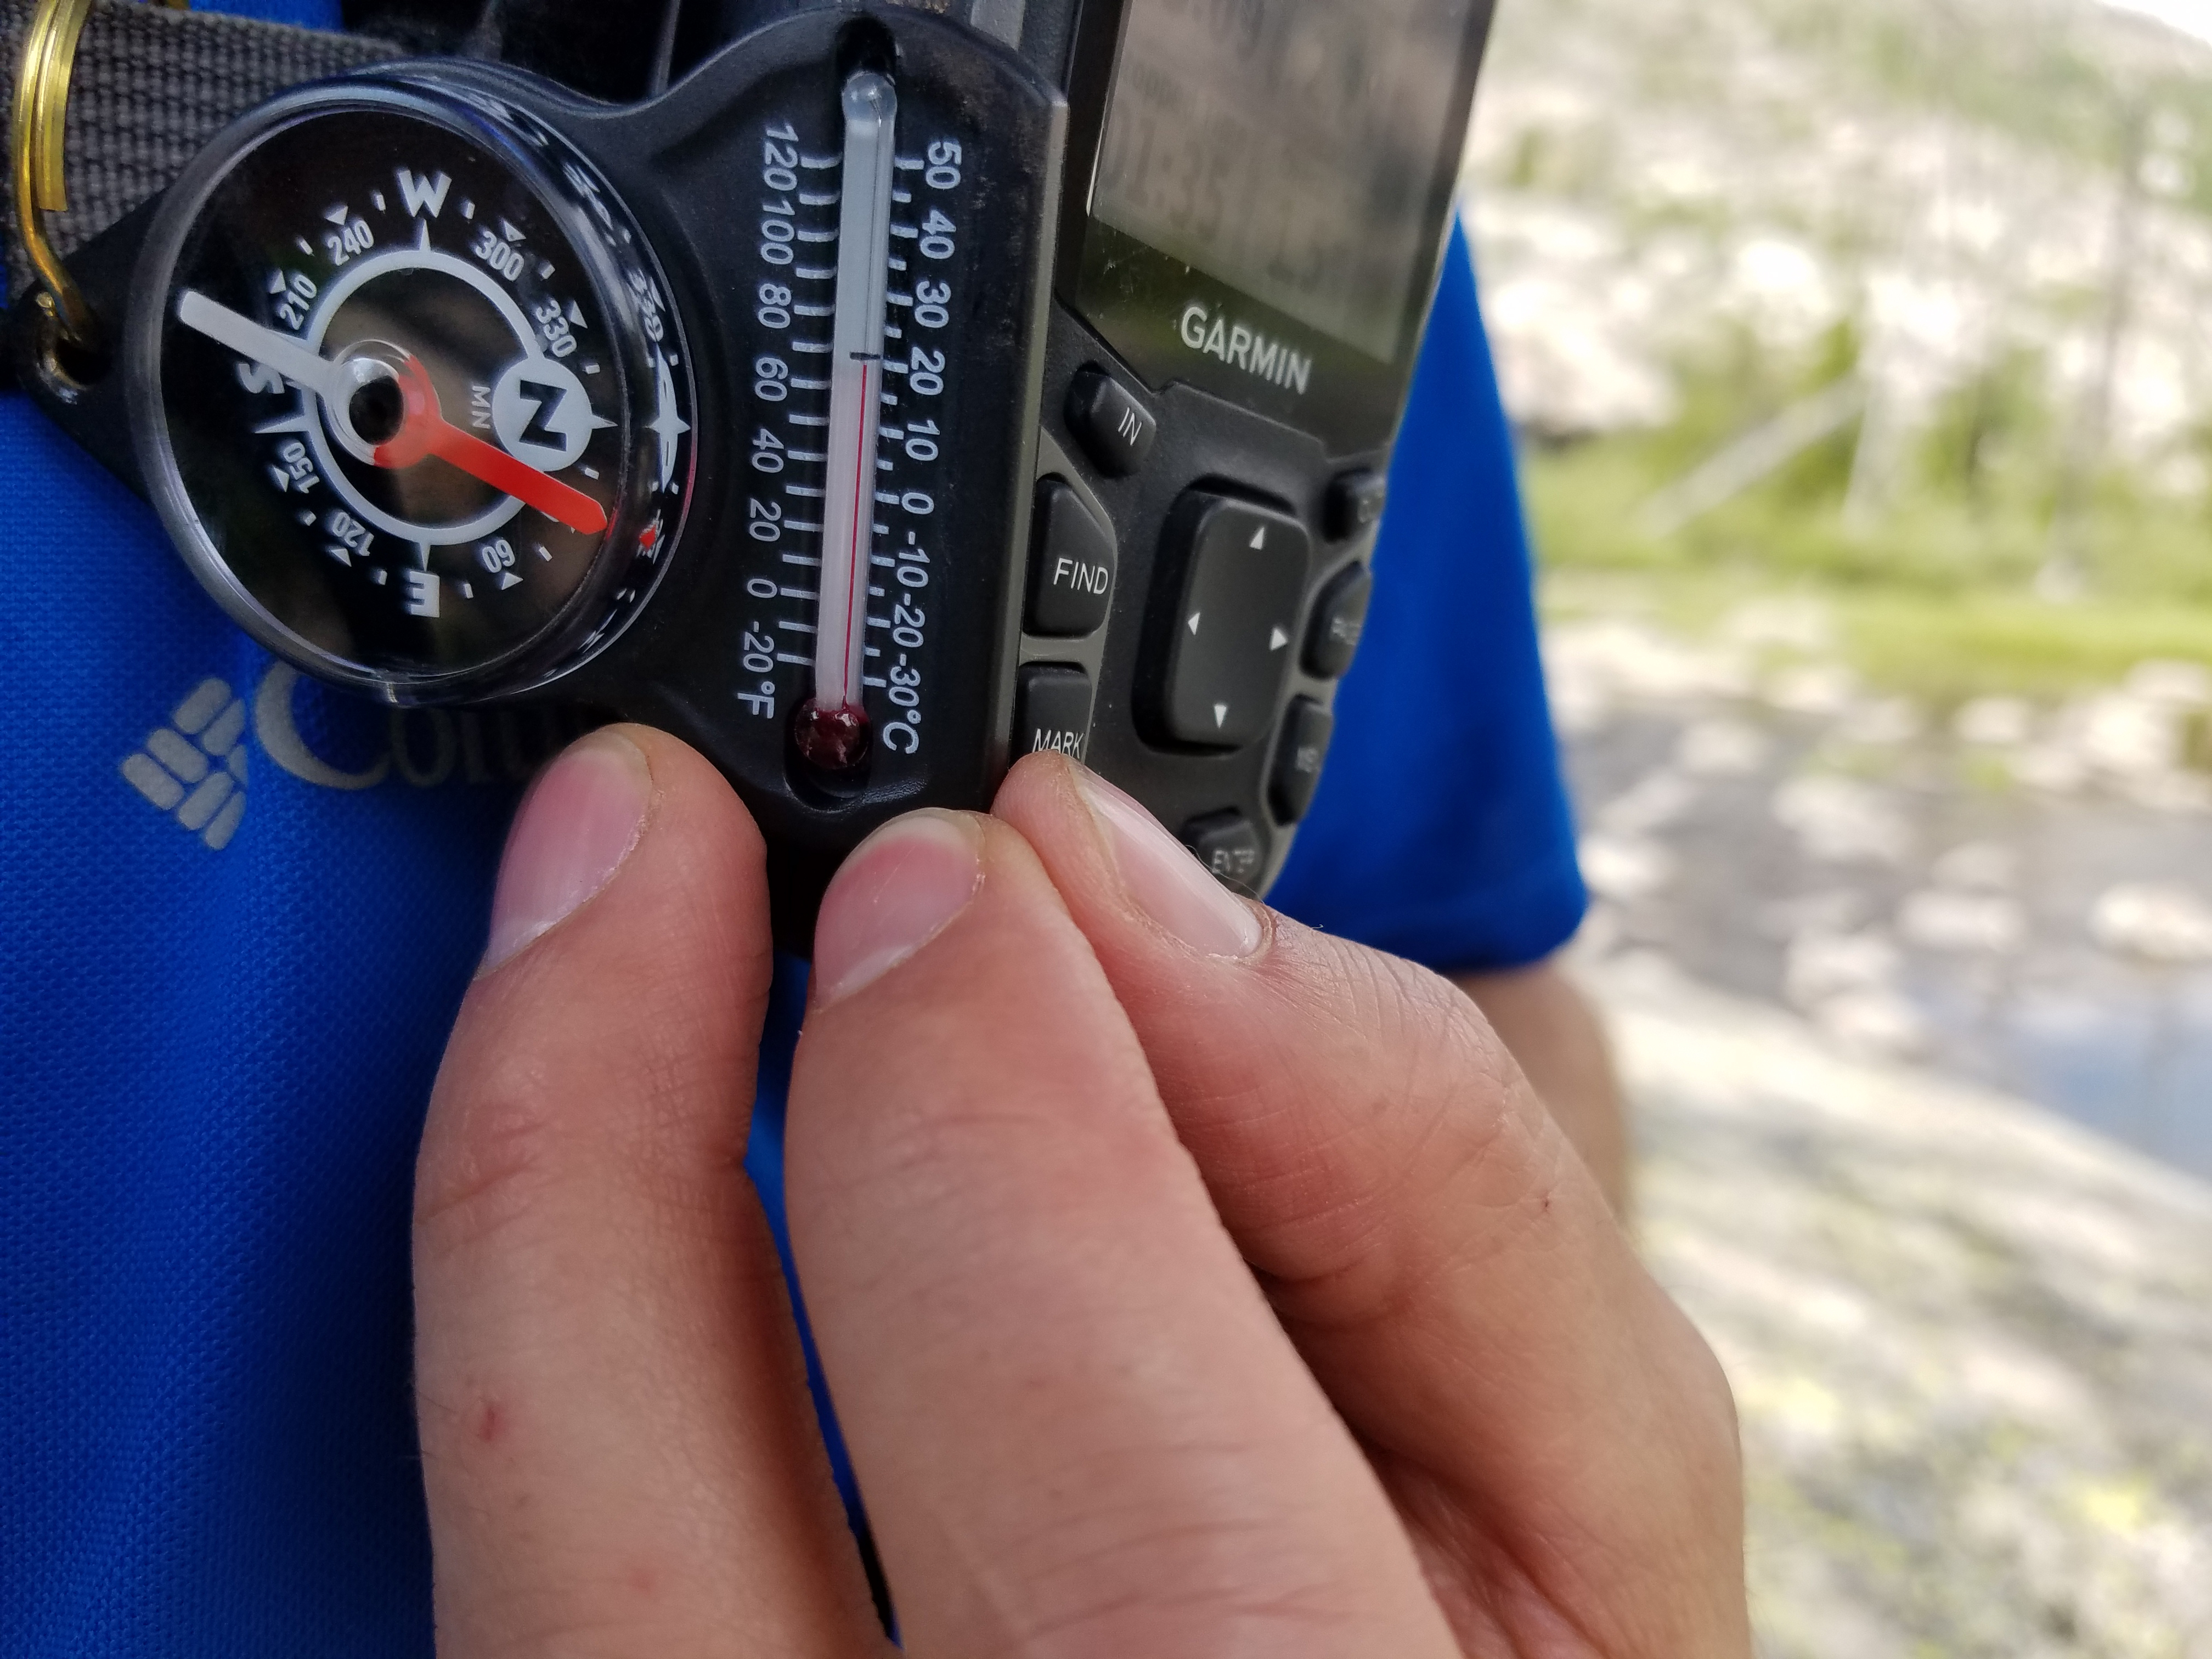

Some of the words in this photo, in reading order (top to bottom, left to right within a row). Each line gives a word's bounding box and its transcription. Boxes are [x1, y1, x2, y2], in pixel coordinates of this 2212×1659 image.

[764, 125, 799, 191] 120
[926, 140, 962, 190] 50
[399, 169, 453, 218] W
[328, 219, 375, 263] 240
[760, 199, 795, 265] 100
[919, 209, 957, 260] 40
[475, 230, 524, 282] 300
[279, 274, 317, 330] 210
[758, 283, 792, 329] 80
[915, 280, 952, 329] 30
[535, 300, 577, 358] 330
[1181, 305, 1312, 394] GARMIN
[755, 357, 789, 402] 60
[910, 346, 945, 396] 20
[519, 380, 567, 452] N
[1118, 407, 1142, 446] IN
[752, 428, 785, 473] 40
[905, 420, 940, 461] 10
[283, 442, 320, 494] 150
[749, 498, 781, 542] 20
[901, 492, 935, 515] 0
[331, 511, 375, 557] 120
[482, 539, 516, 573] 60
[409, 571, 441, 618] E
[747, 578, 778, 599] 0
[1053, 557, 1109, 595] FIND
[1032, 727, 1085, 759] MARK
